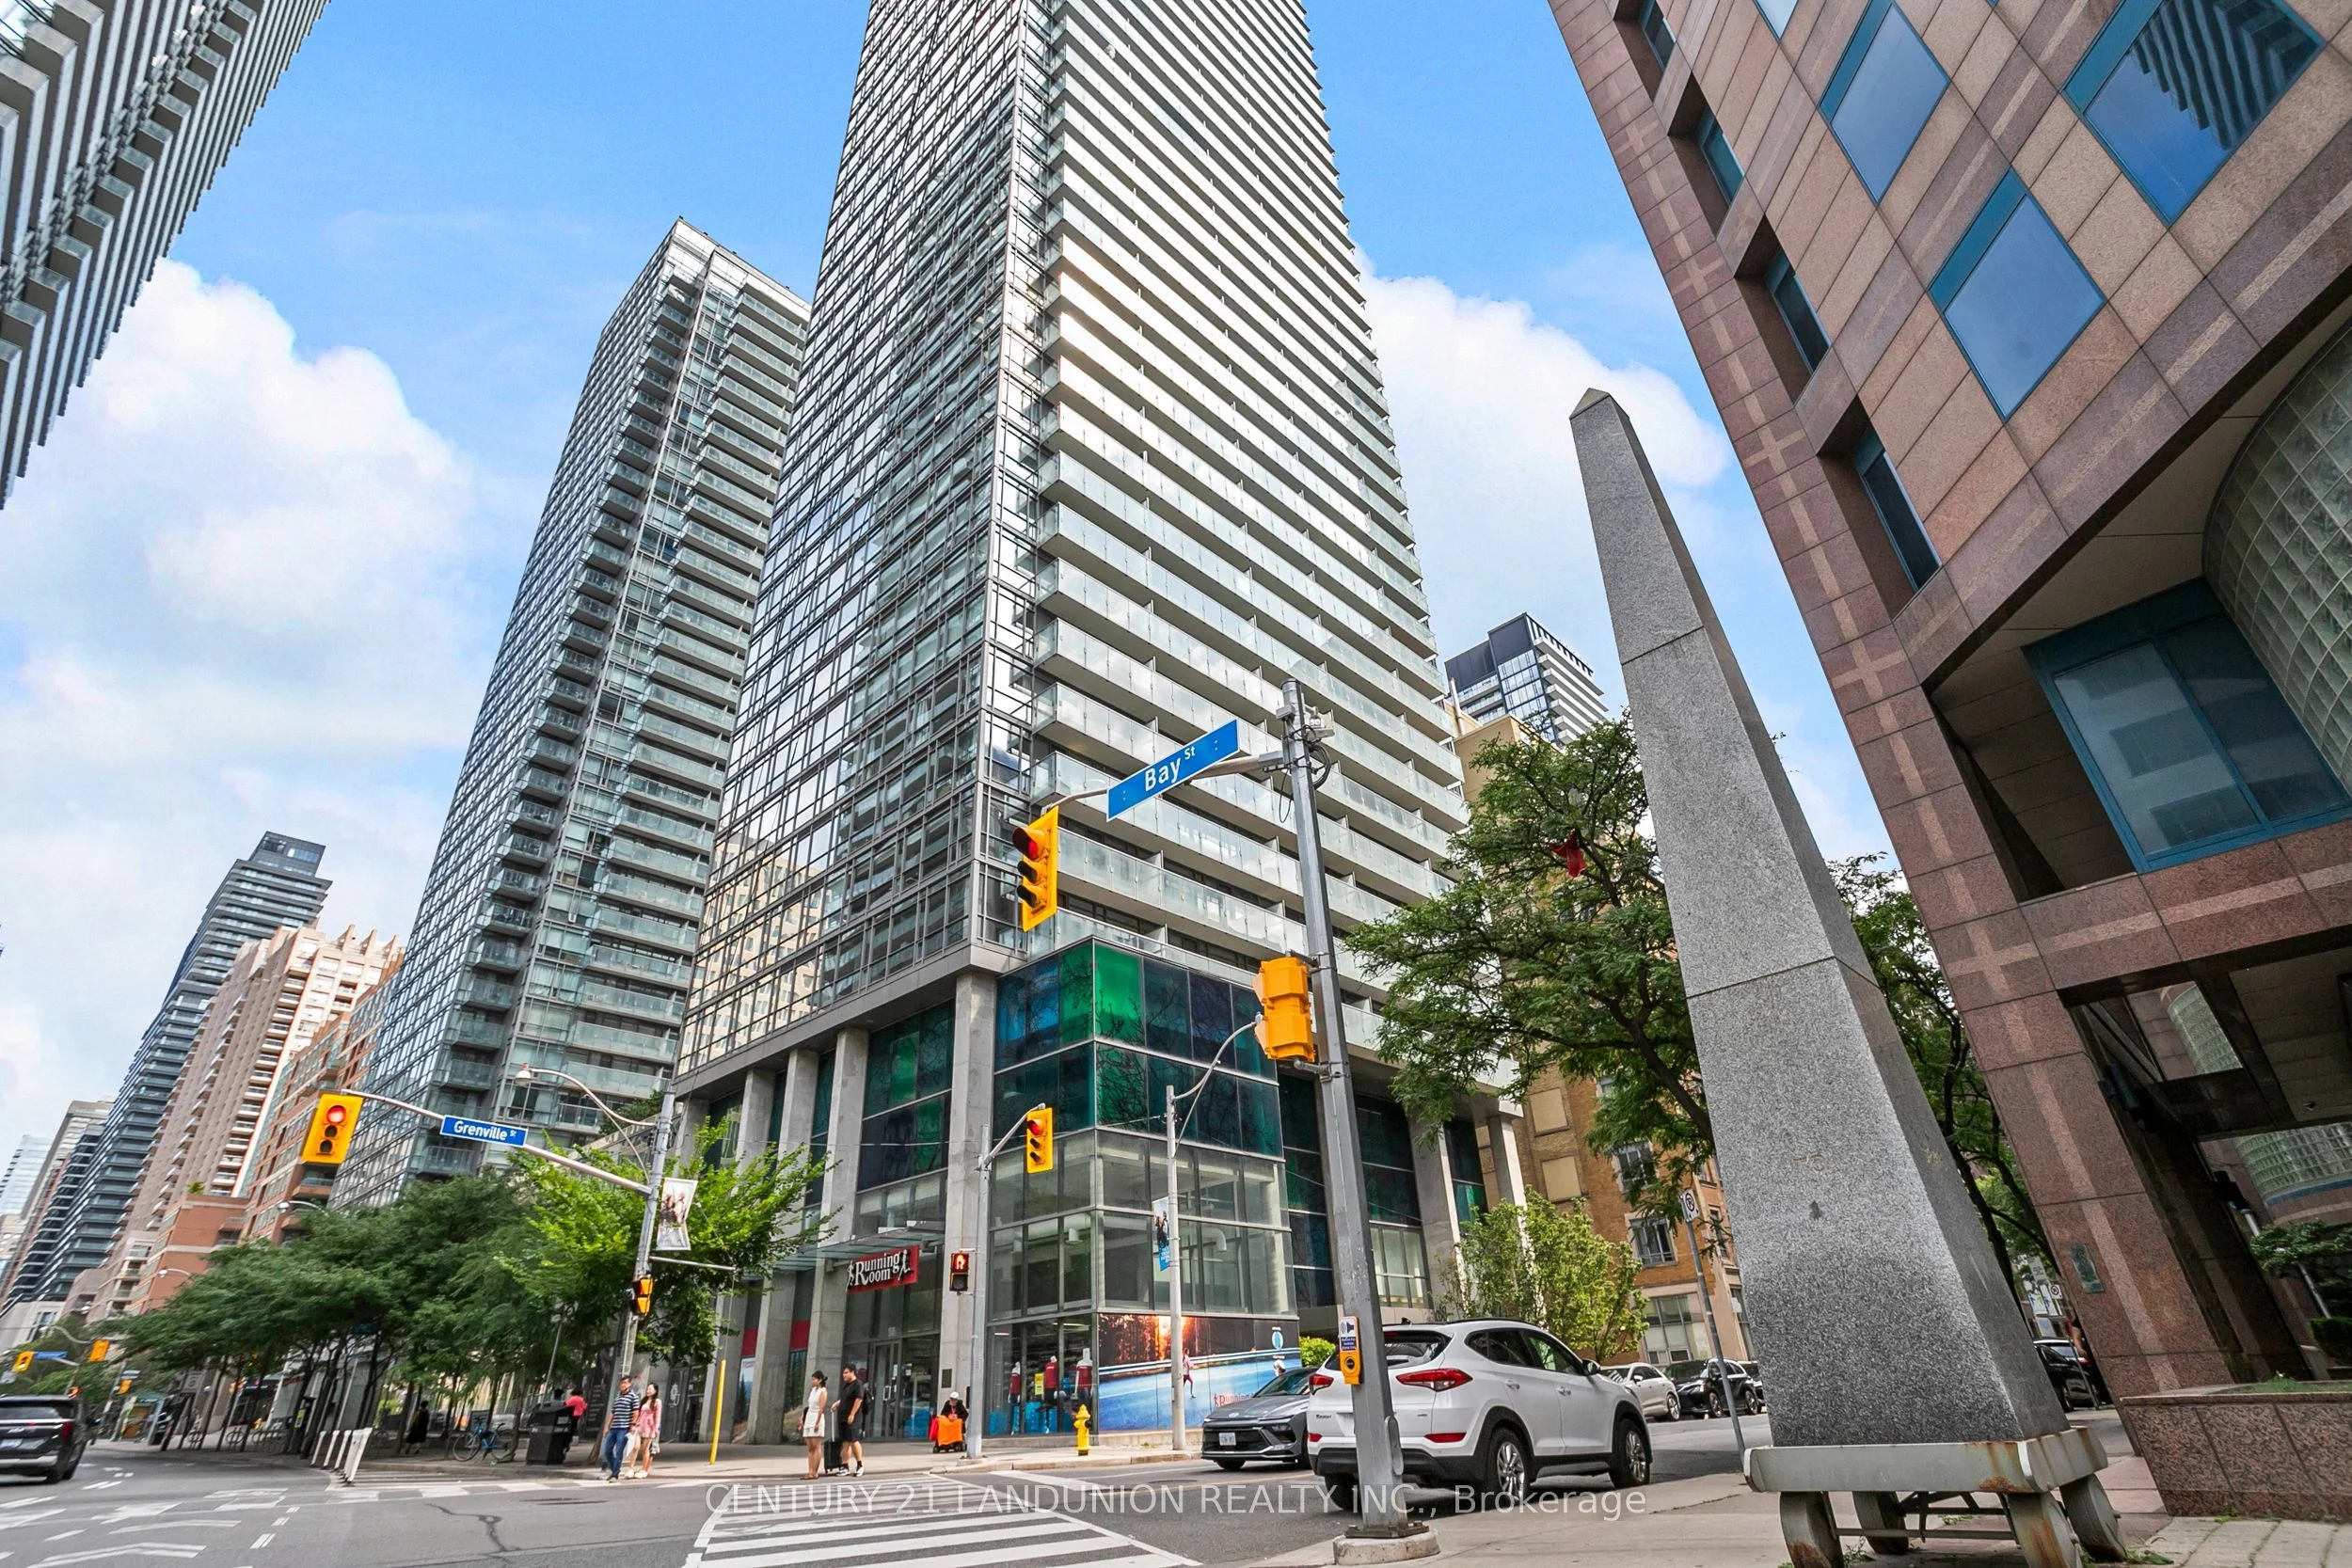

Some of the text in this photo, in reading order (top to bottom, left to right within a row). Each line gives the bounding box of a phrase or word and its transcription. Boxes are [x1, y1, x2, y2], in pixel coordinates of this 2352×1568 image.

[1144, 745, 1196, 792] Bay St
[453, 1120, 508, 1141] Grenville
[854, 1251, 901, 1281] Running
[854, 1261, 891, 1286] Room
